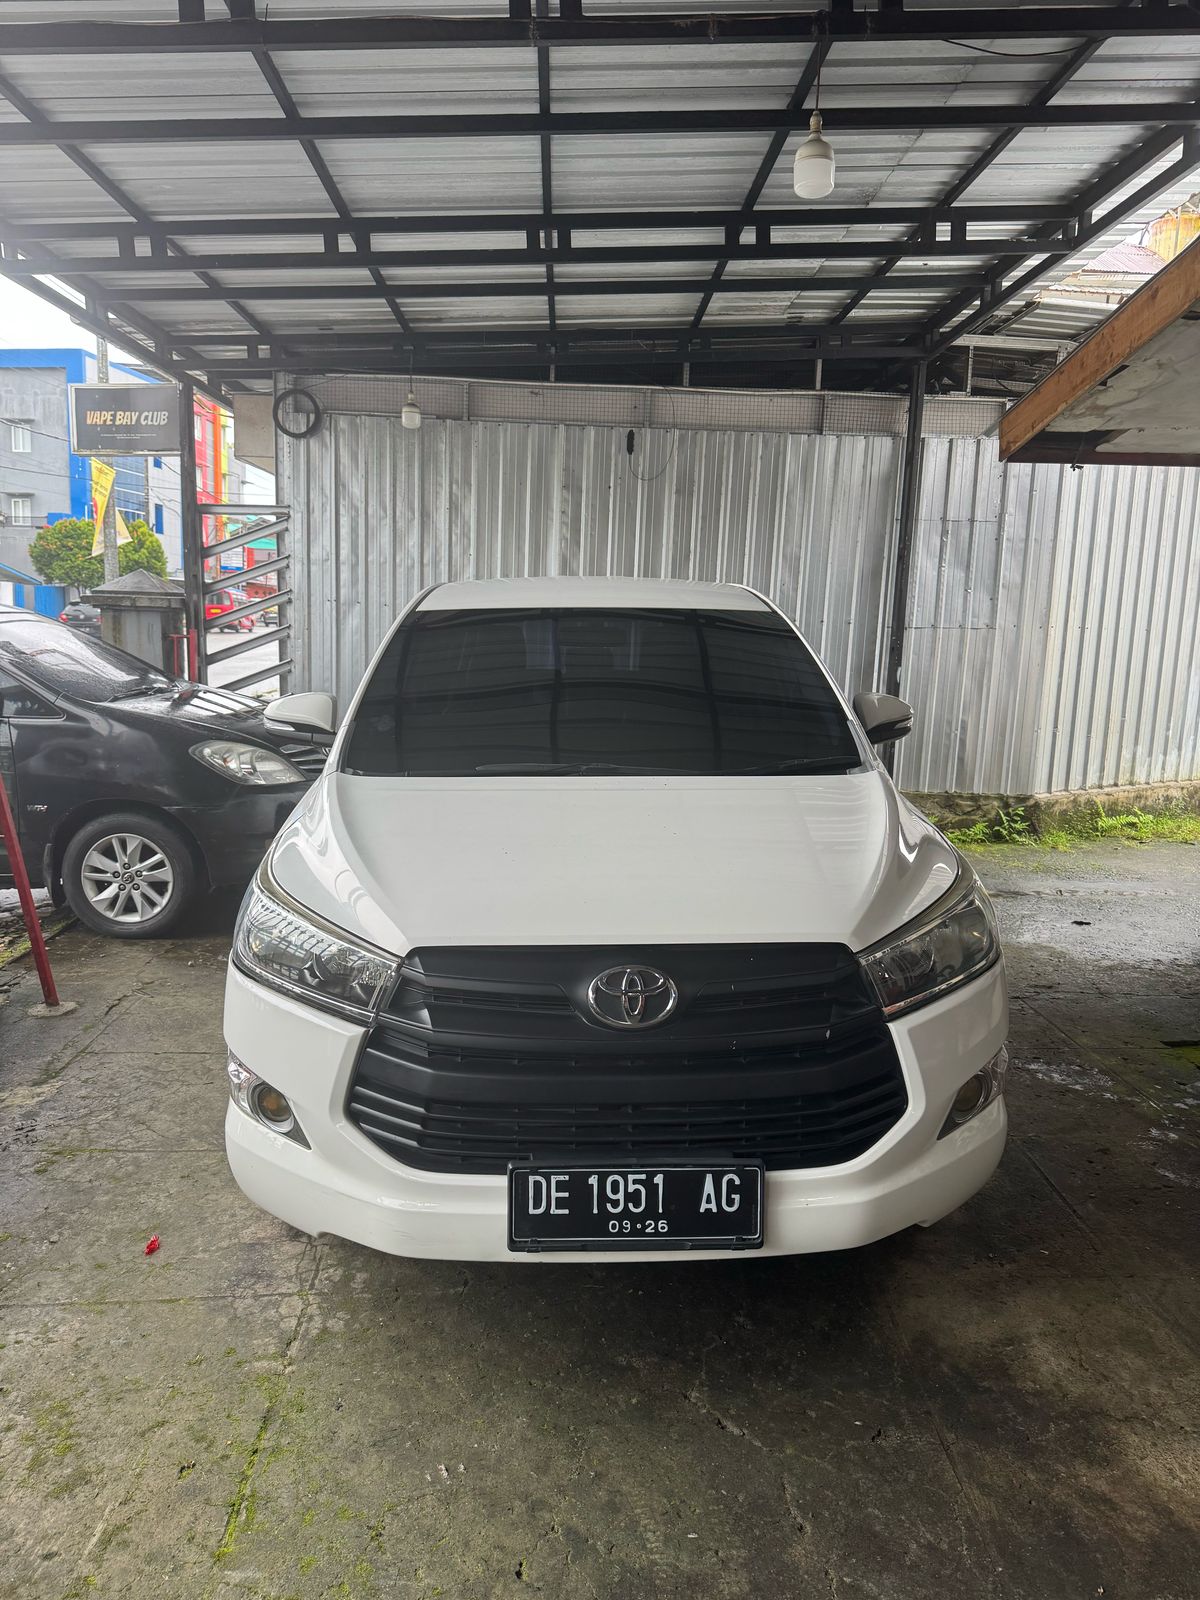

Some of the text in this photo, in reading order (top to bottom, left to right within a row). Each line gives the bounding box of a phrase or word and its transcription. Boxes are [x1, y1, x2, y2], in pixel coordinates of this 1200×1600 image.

[86, 411, 169, 425] VAPE BAY CLUB
[528, 1173, 741, 1215] DE 1951 AG
